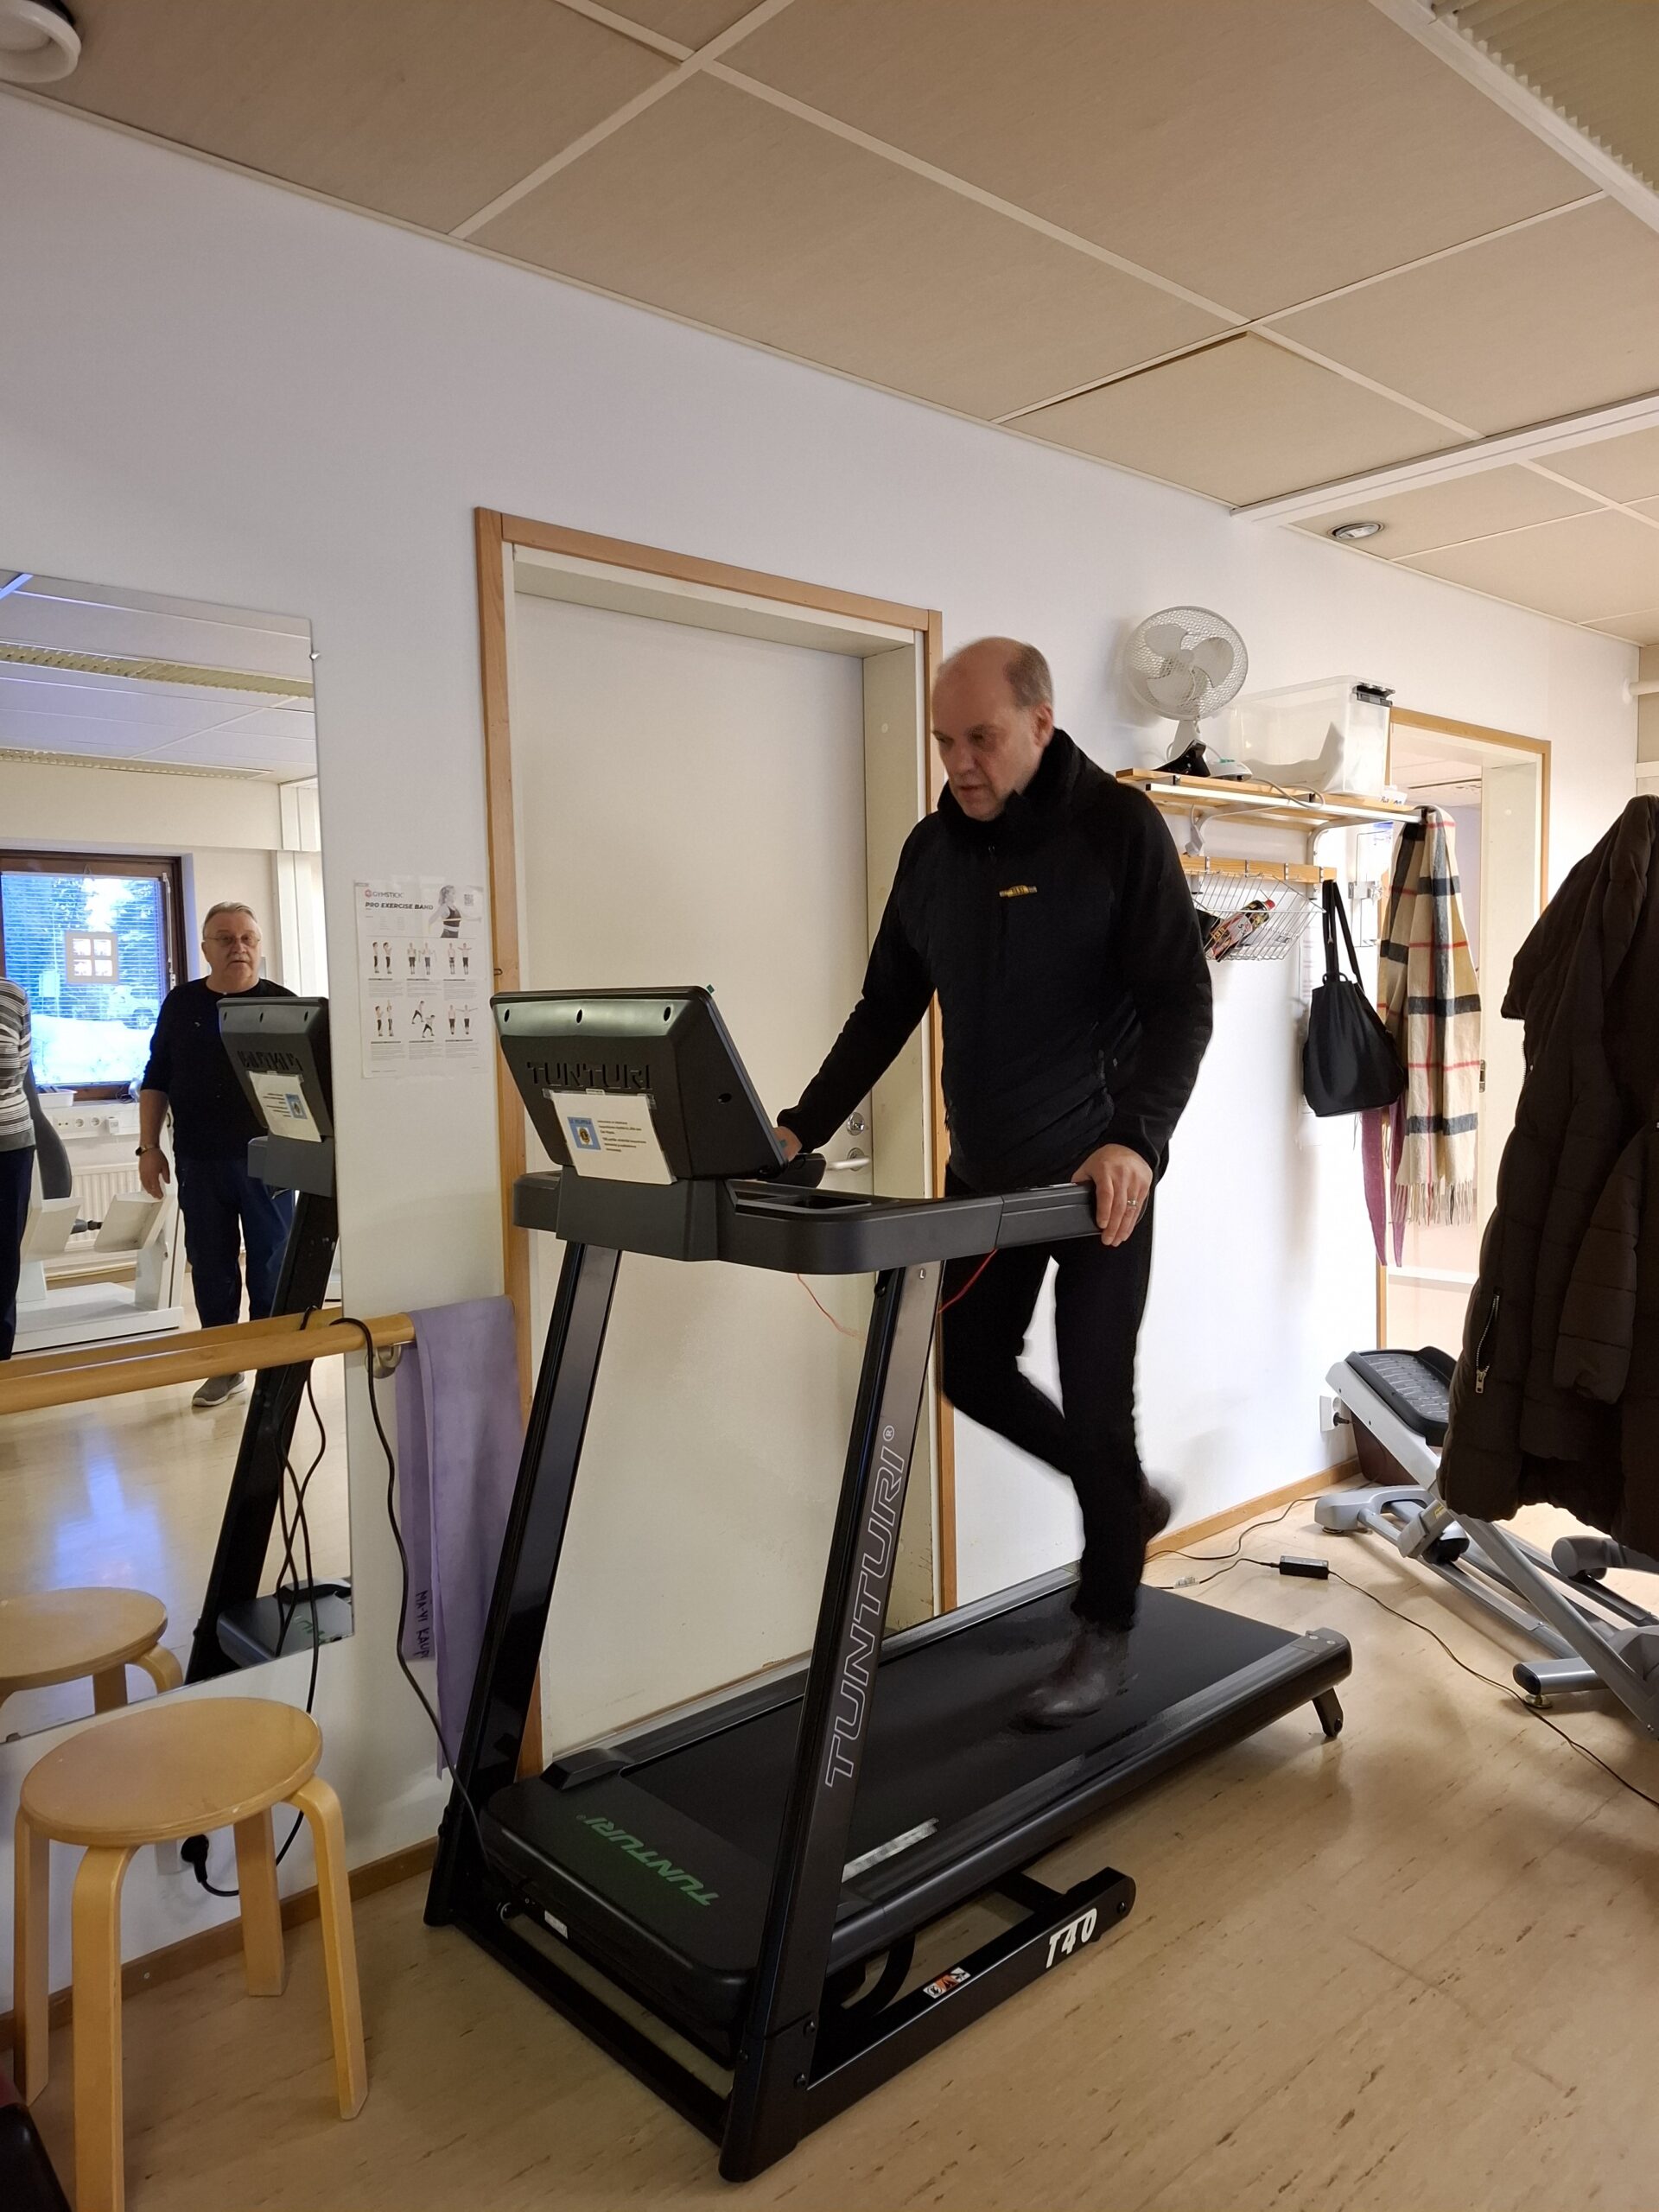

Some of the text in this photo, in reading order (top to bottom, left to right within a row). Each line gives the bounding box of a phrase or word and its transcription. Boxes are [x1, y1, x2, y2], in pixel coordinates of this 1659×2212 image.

[526, 1061, 653, 1090] TUNTURI
[582, 1817, 719, 1906] TUNTURI
[1046, 1908, 1097, 1968] T40
